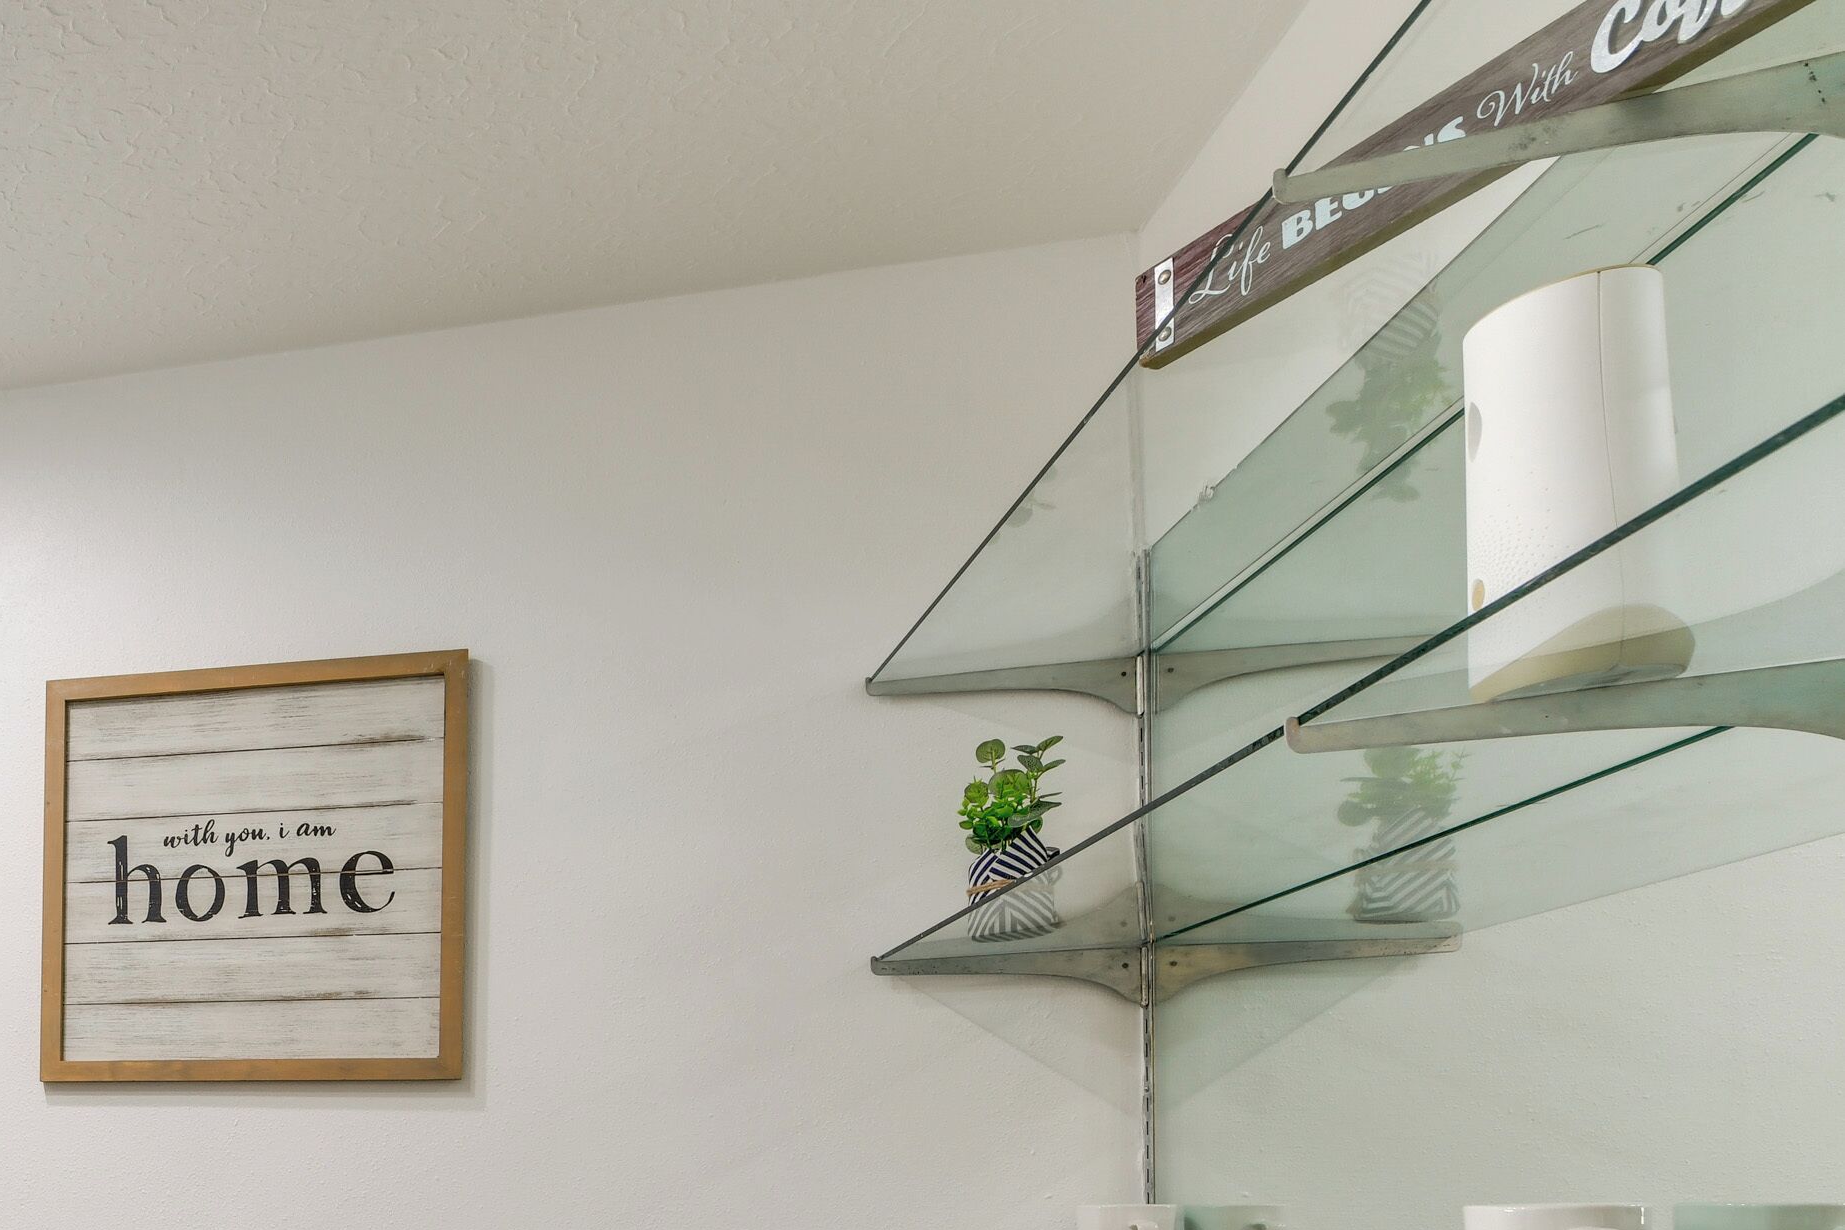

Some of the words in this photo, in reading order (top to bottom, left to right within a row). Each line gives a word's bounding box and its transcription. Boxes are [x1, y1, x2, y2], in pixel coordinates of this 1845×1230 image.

[1188, 226, 1271, 304] Life
[1476, 50, 1579, 127] With
[163, 818, 219, 849] with
[278, 822, 291, 839] i
[296, 822, 337, 838] am
[106, 834, 396, 925] home
